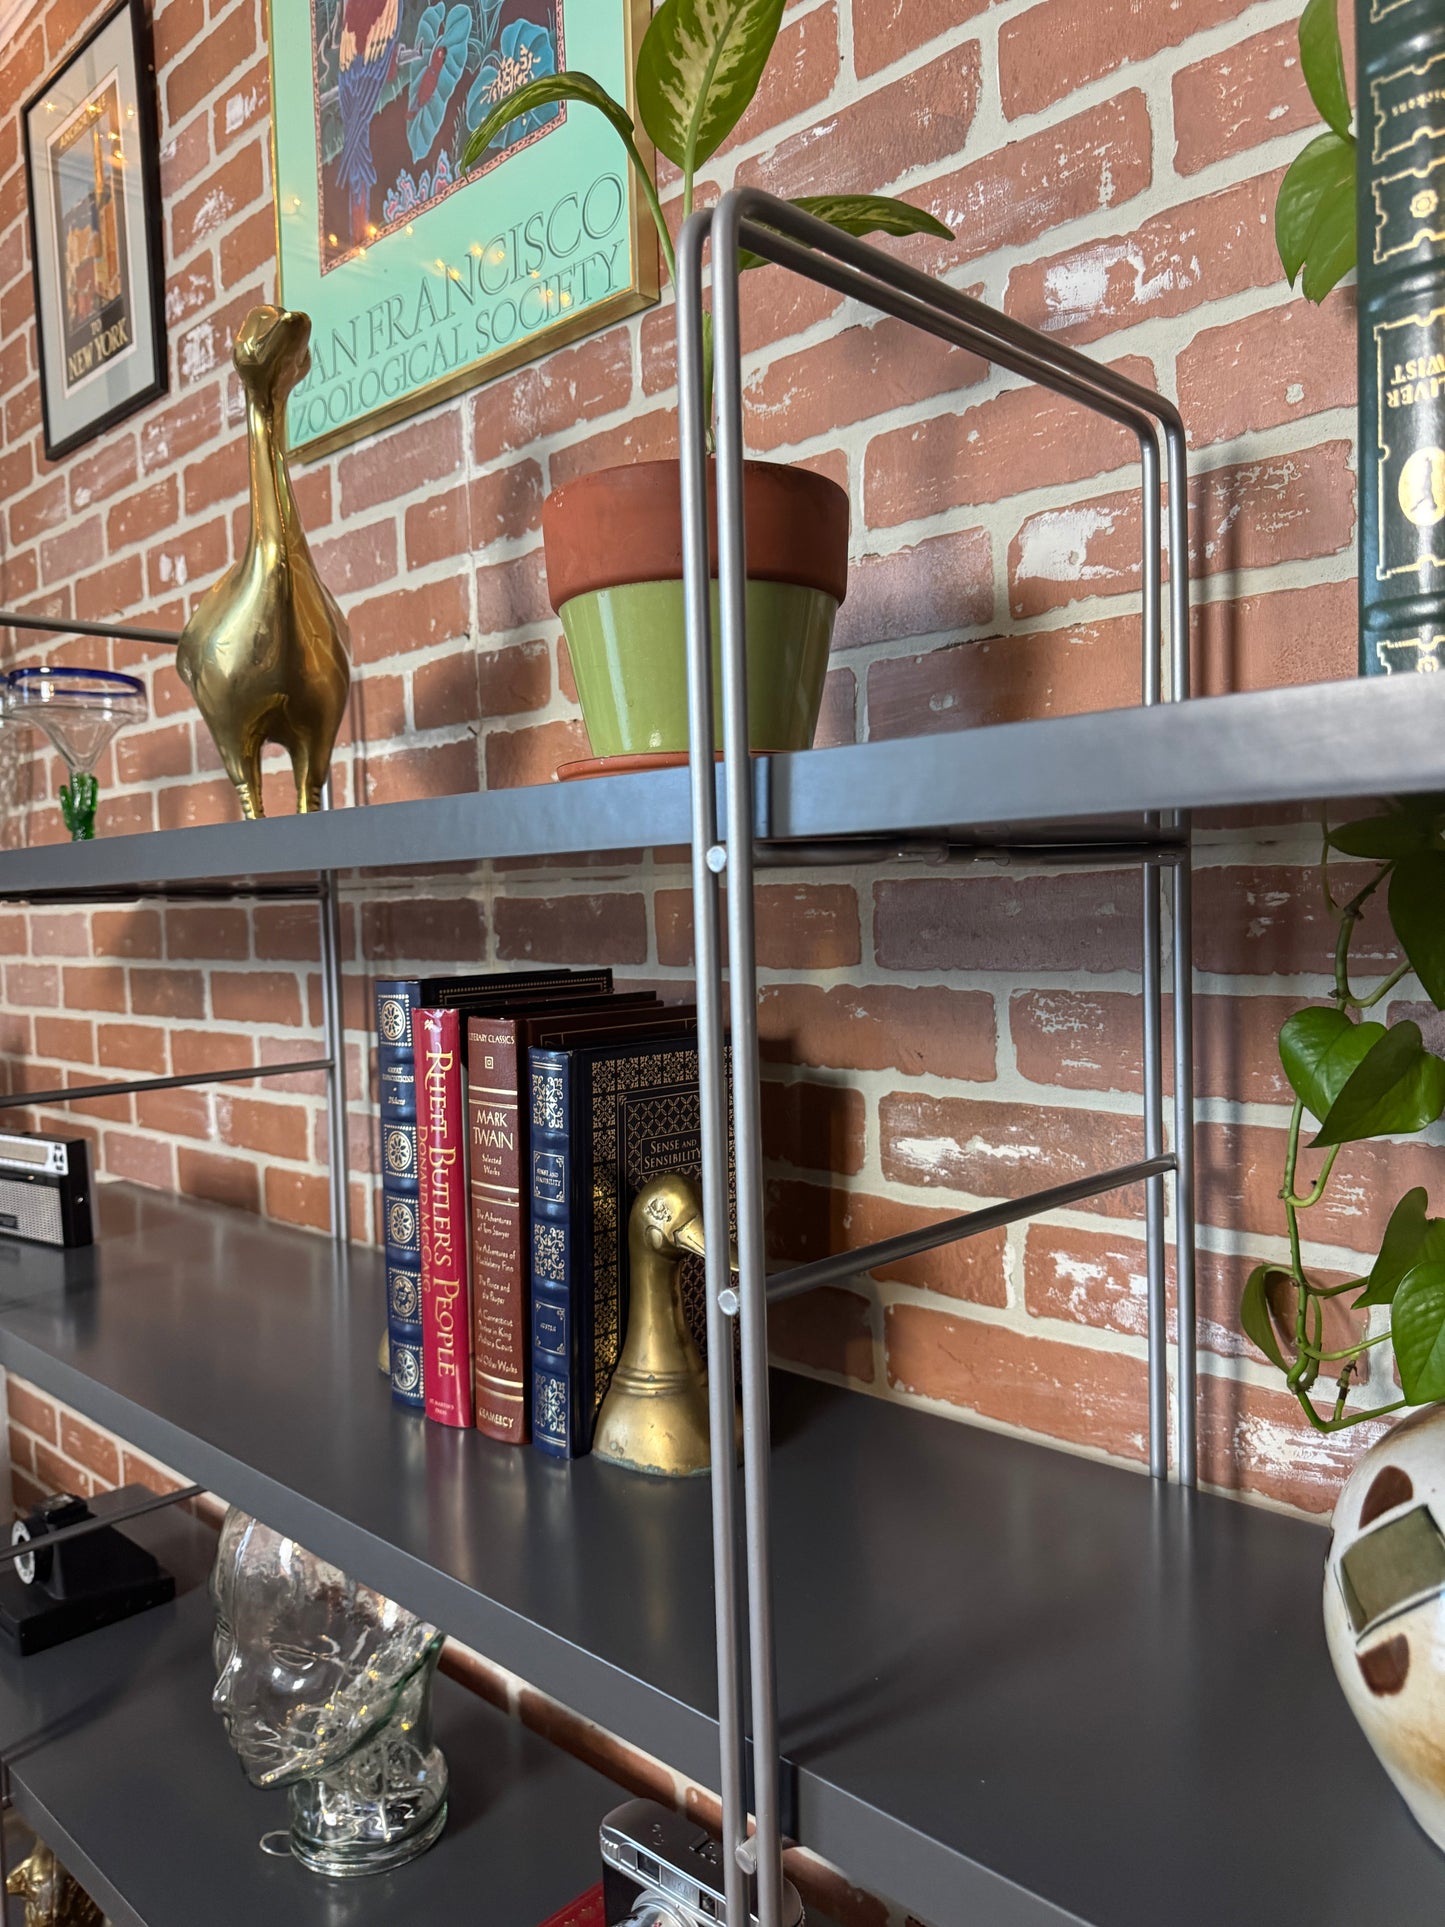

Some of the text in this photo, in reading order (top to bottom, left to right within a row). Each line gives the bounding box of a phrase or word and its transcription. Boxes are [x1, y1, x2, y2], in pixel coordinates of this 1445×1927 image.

[366, 171, 625, 360] FRANCISCO
[90, 318, 102, 335] TO
[67, 317, 129, 381] NEW YORK
[291, 239, 625, 443] ZOOLOGICAL SOCIETY
[487, 1034, 515, 1045] CLASSICS
[476, 1110, 507, 1128] MARK
[473, 1126, 514, 1151] TWAIN
[650, 1139, 697, 1155] SENSE AND
[418, 1126, 429, 1206] DONALD
[644, 1147, 701, 1170] SENSIBILITY
[425, 1042, 460, 1377] RHETT BUTLER'S PEOPLE
